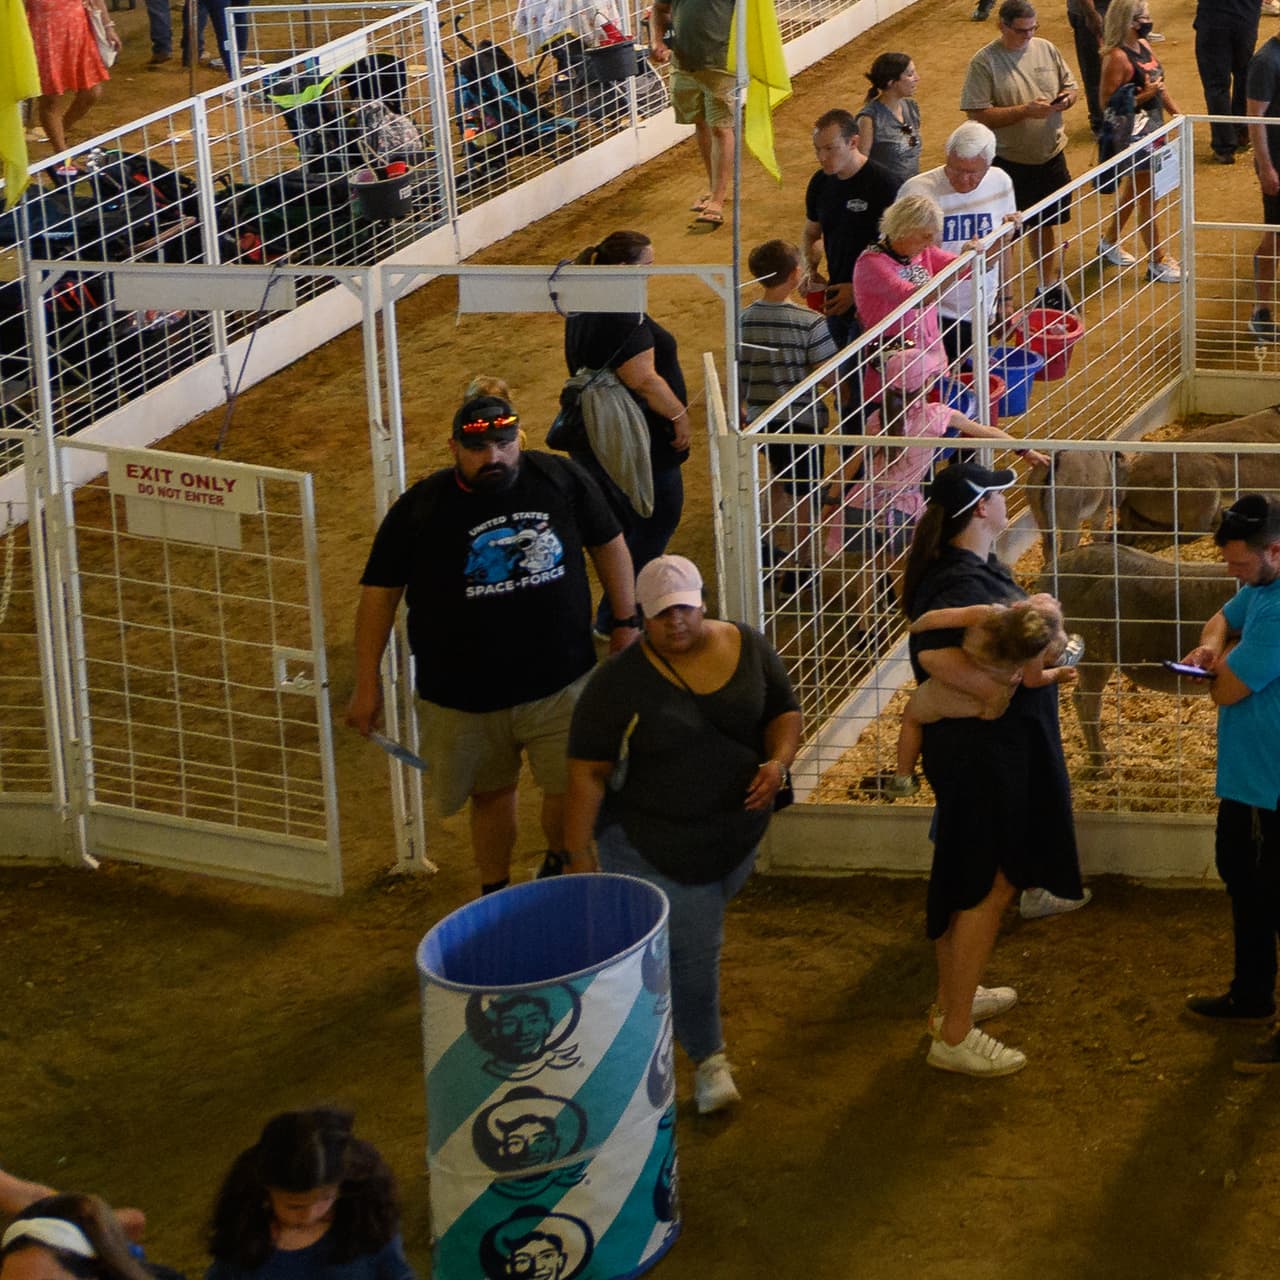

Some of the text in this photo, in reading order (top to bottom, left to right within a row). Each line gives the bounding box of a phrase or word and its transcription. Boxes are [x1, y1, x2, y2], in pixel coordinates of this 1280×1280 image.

[126, 463, 237, 493] EXIT ONLY
[138, 483, 225, 507] DO NOT ENTER
[468, 512, 550, 536] UNITED STATES
